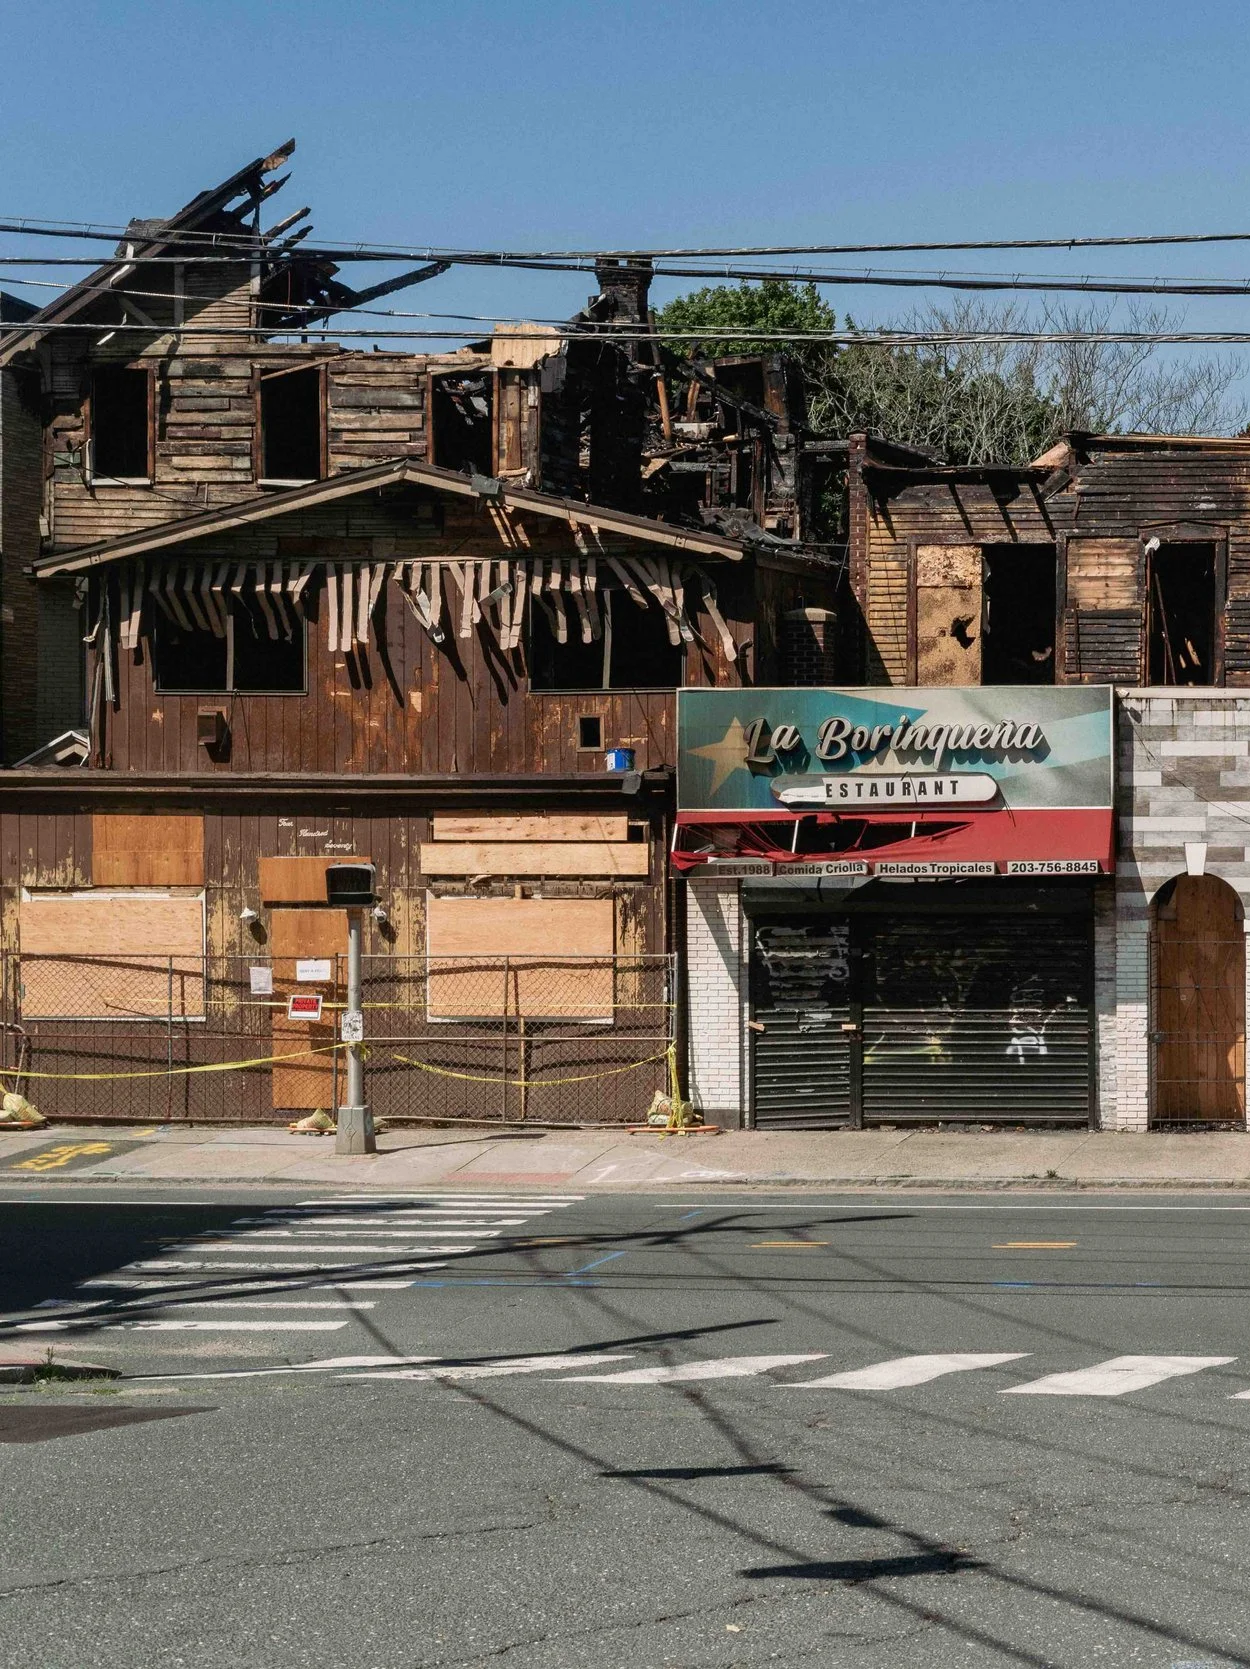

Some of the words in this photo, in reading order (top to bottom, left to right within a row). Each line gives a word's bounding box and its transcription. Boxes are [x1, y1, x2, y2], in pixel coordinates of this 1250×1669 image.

[745, 717, 801, 763] La
[815, 714, 1044, 770] Borinqueña
[825, 779, 960, 798] ESTAURANT
[779, 863, 823, 875] Comida
[825, 862, 863, 874] Criolla
[879, 863, 928, 874] Helados
[930, 863, 992, 874] Tropicales
[1011, 862, 1097, 873] 203-756-8845
